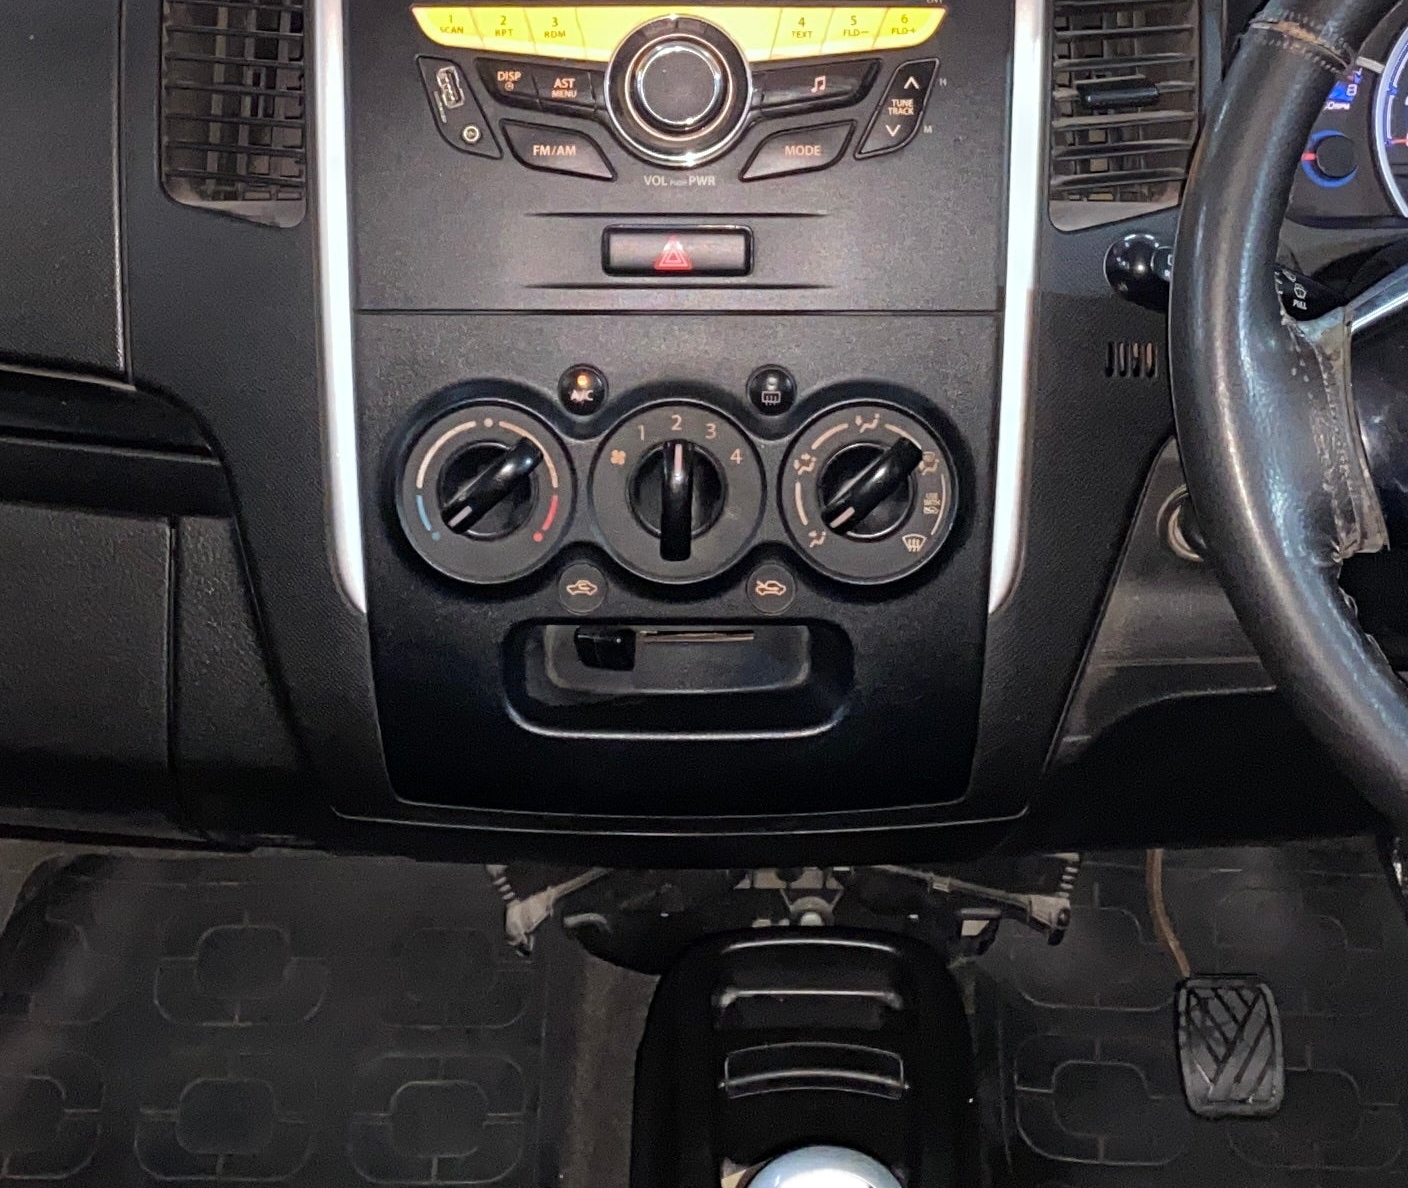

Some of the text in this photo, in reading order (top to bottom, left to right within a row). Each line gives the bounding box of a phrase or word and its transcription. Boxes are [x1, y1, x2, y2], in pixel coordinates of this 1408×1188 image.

[500, 15, 507, 25] 2
[552, 17, 559, 27] 3
[798, 17, 805, 27] 4
[850, 15, 857, 25] 5
[900, 14, 909, 24] 6
[440, 26, 464, 34] SCAN
[495, 28, 514, 37] RPT
[544, 30, 566, 38] RDM
[792, 30, 813, 38] TEXT
[497, 71, 522, 82] DISP
[553, 78, 576, 89] AST
[551, 89, 578, 98] MENU
[1346, 83, 1358, 97] 8
[892, 98, 914, 107] TUNE
[888, 106, 914, 115] TRACK
[923, 125, 933, 134] M
[533, 145, 577, 156] FM/AM
[785, 145, 821, 156] MODE
[643, 175, 668, 186] VOL
[688, 175, 716, 186] PWR
[1293, 299, 1307, 310] PULL
[570, 389, 594, 403] A/C
[671, 414, 683, 431] 2
[638, 425, 645, 441] 1
[705, 423, 717, 440] 3
[729, 448, 743, 465] 4
